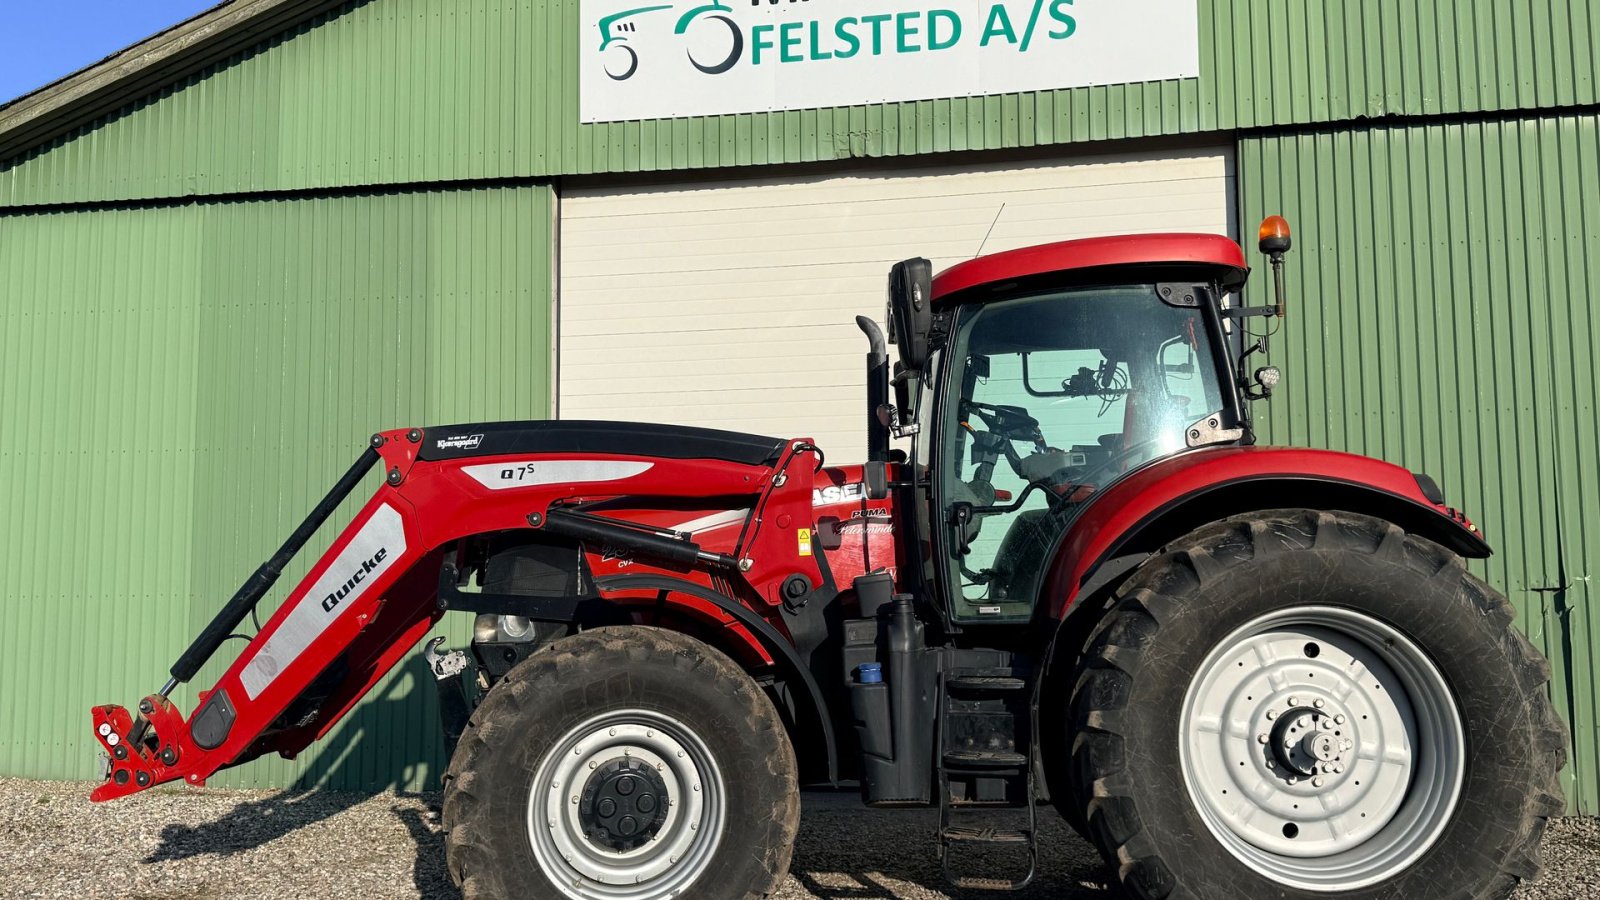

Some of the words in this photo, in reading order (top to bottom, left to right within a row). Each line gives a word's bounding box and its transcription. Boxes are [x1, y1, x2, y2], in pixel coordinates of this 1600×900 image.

[752, 9, 962, 65] FELSTED
[979, 0, 1077, 52] A/S
[852, 508, 888, 518] PUMA
[321, 547, 387, 613] Quicke
